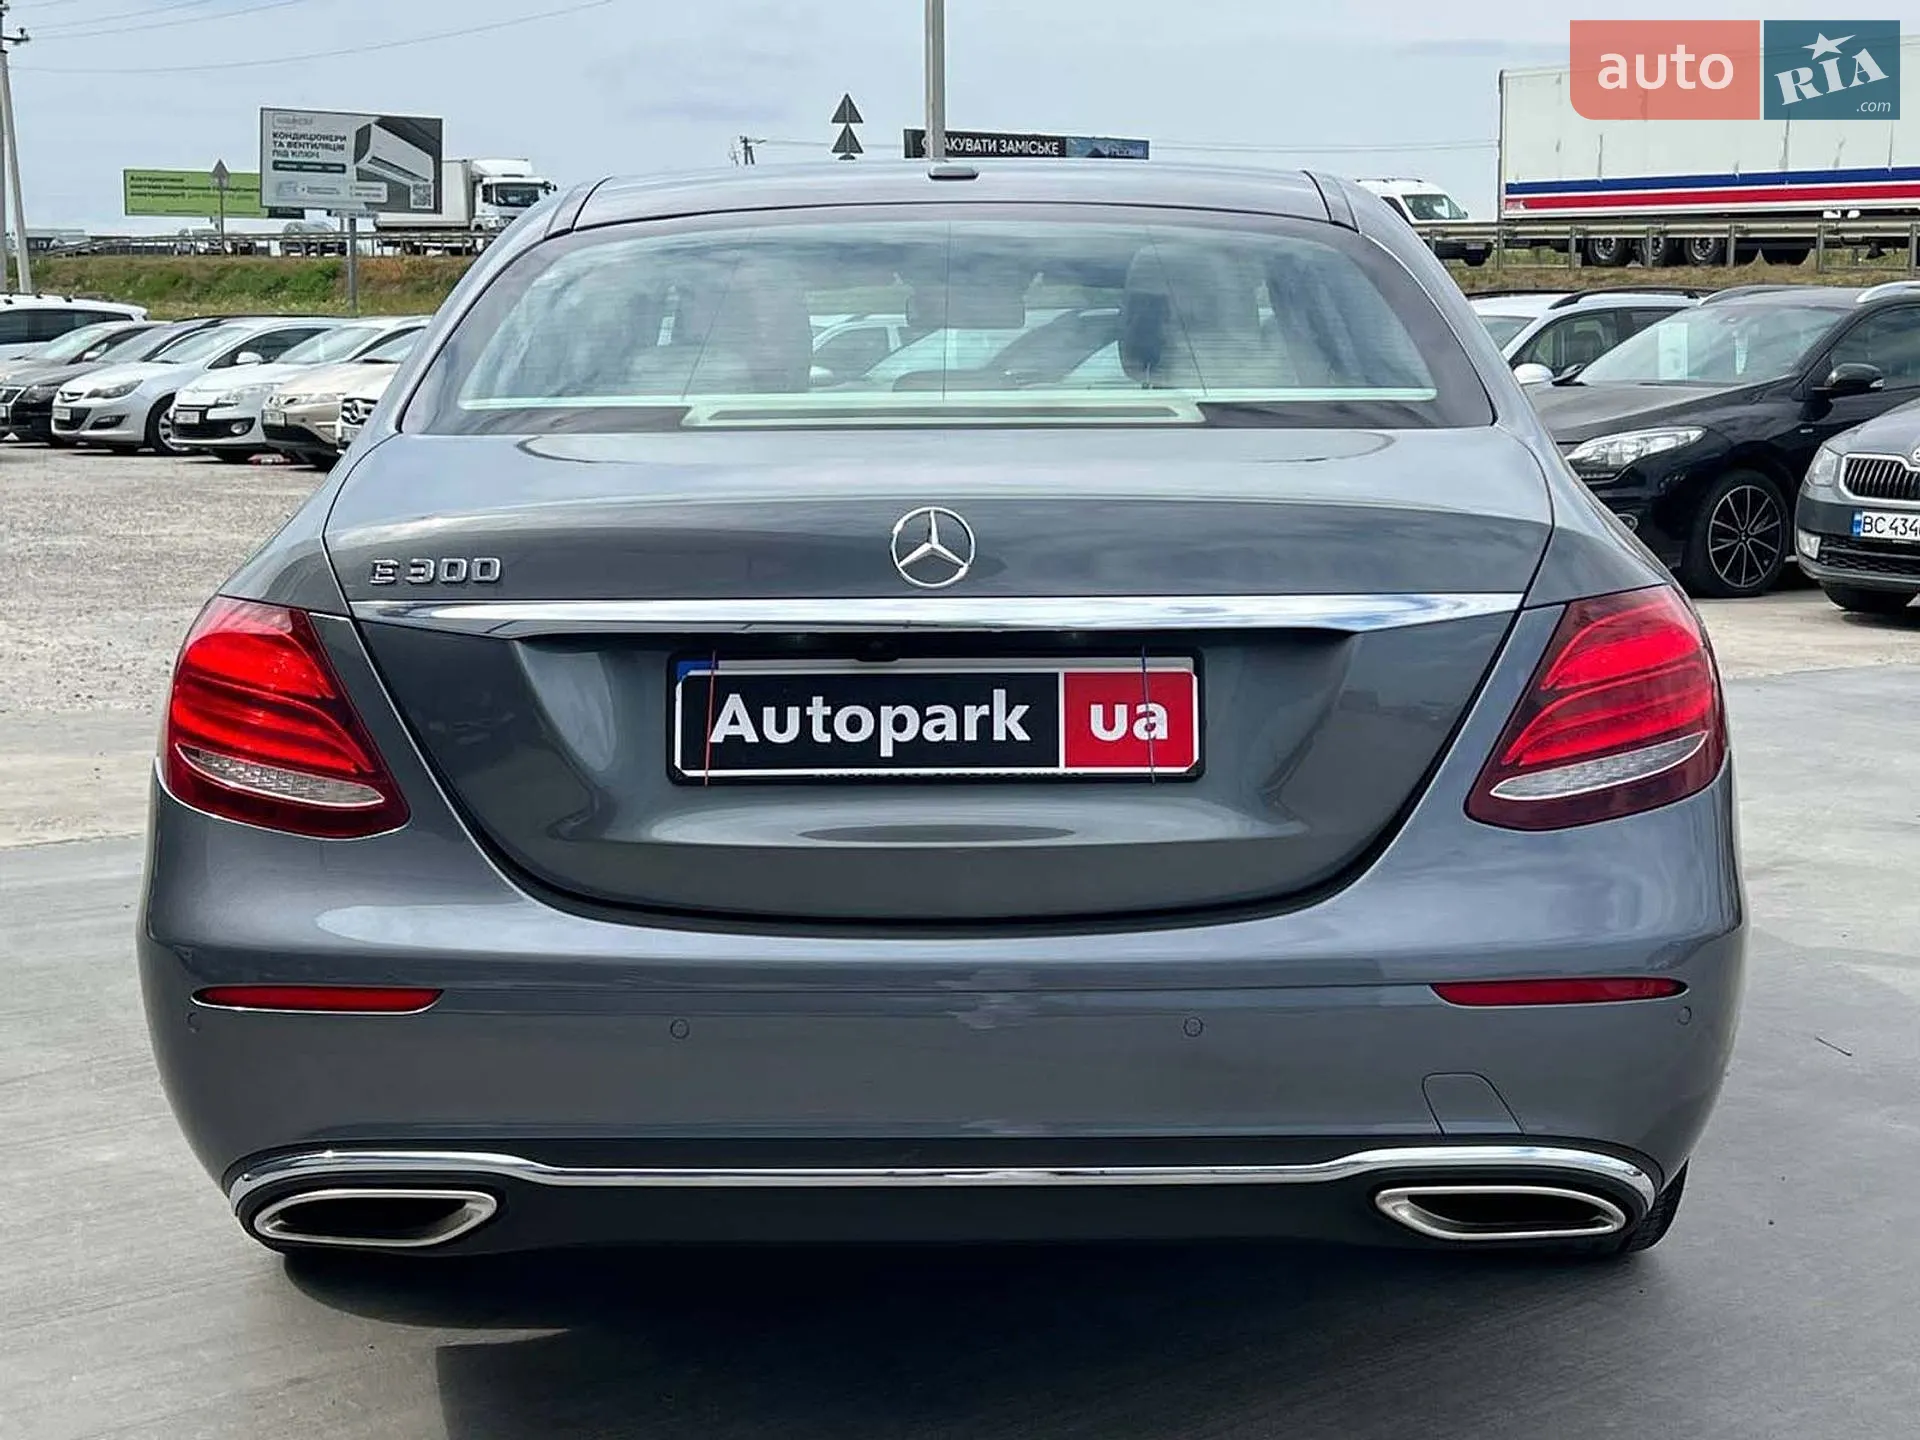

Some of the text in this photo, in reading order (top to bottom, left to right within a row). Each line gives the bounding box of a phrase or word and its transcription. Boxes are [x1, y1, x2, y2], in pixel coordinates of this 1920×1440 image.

[1000, 141, 1059, 155] ЗАМІСЬКЕ
[1863, 516, 1920, 537] BC 434
[369, 557, 501, 586] E 300
[709, 689, 1168, 758] Autopark ua
